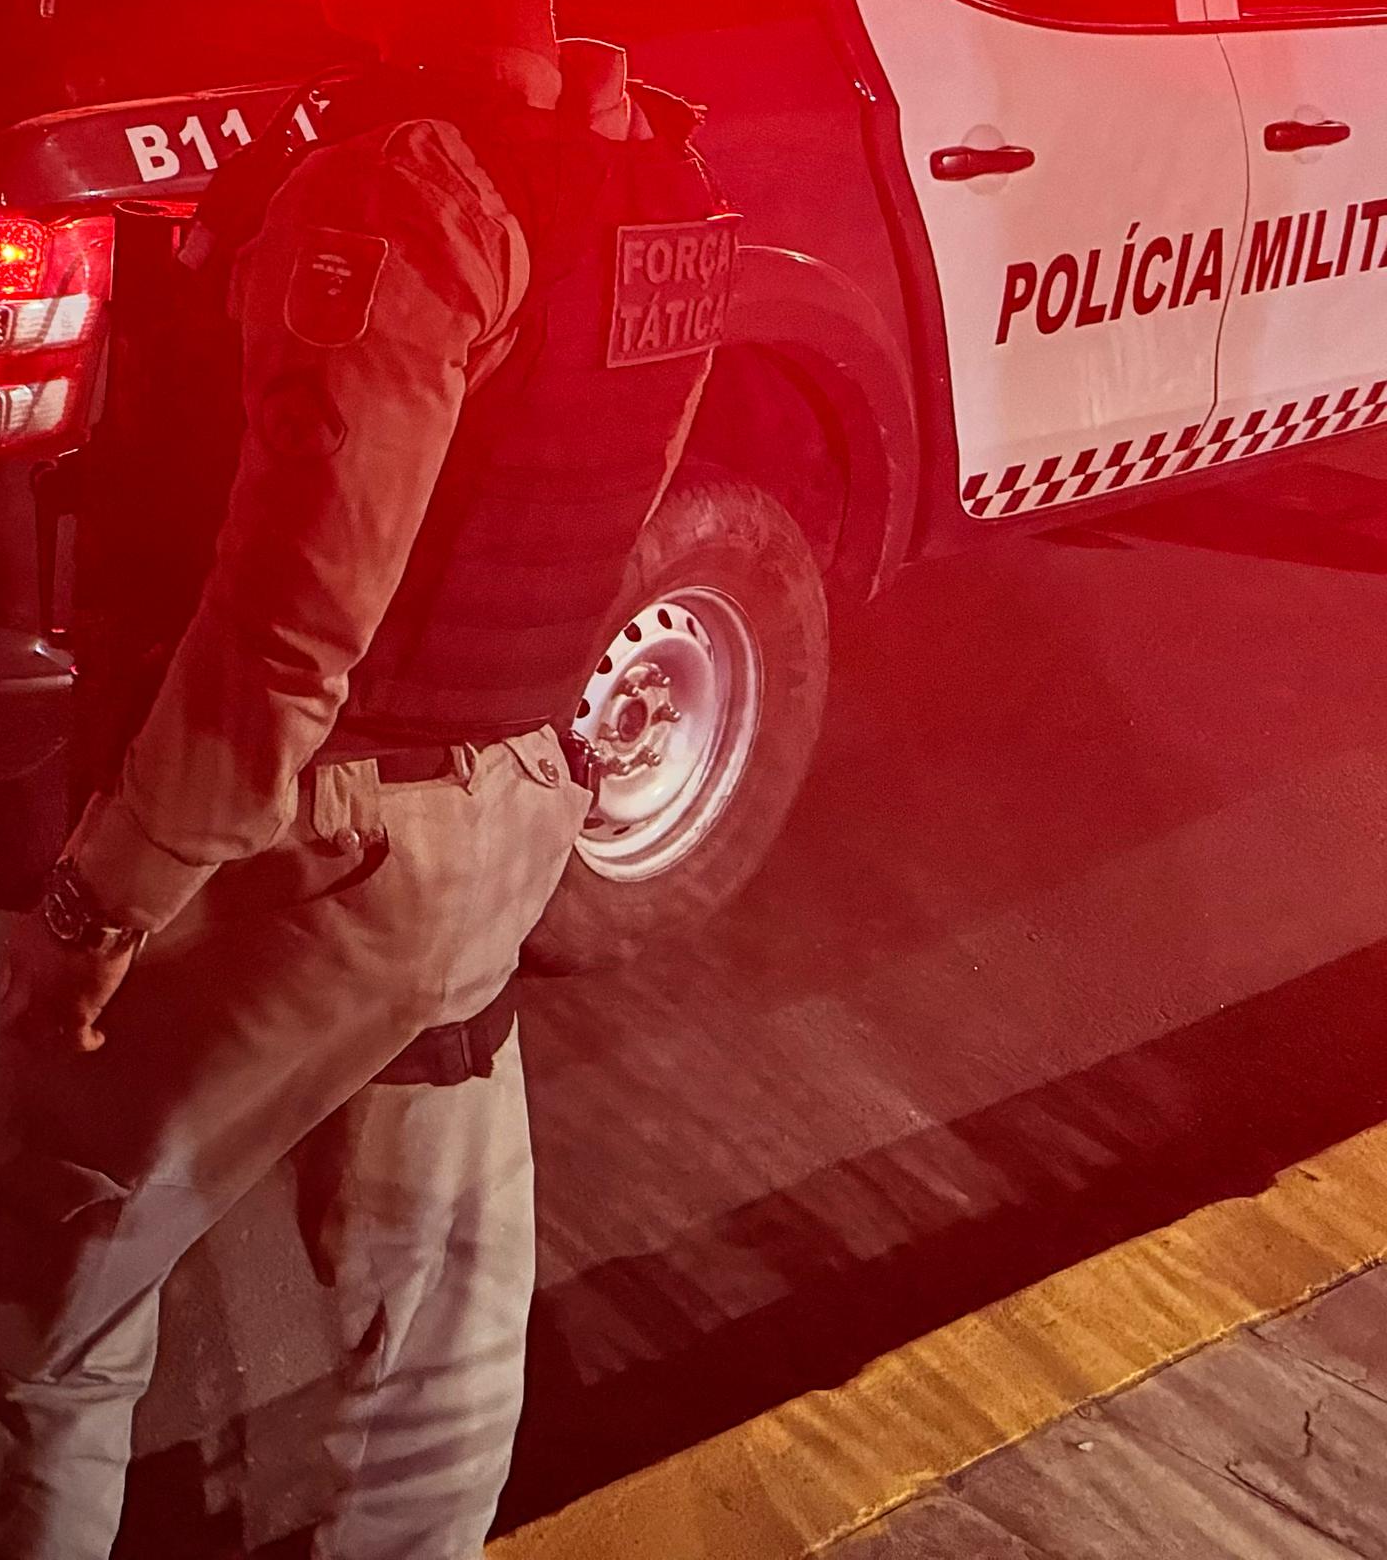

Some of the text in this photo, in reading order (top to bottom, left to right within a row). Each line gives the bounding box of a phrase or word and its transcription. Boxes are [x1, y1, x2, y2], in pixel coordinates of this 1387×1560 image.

[623, 229, 731, 290] FORÇA
[995, 221, 1224, 345] POLÍCIA
[620, 290, 728, 352] TÁTICA
